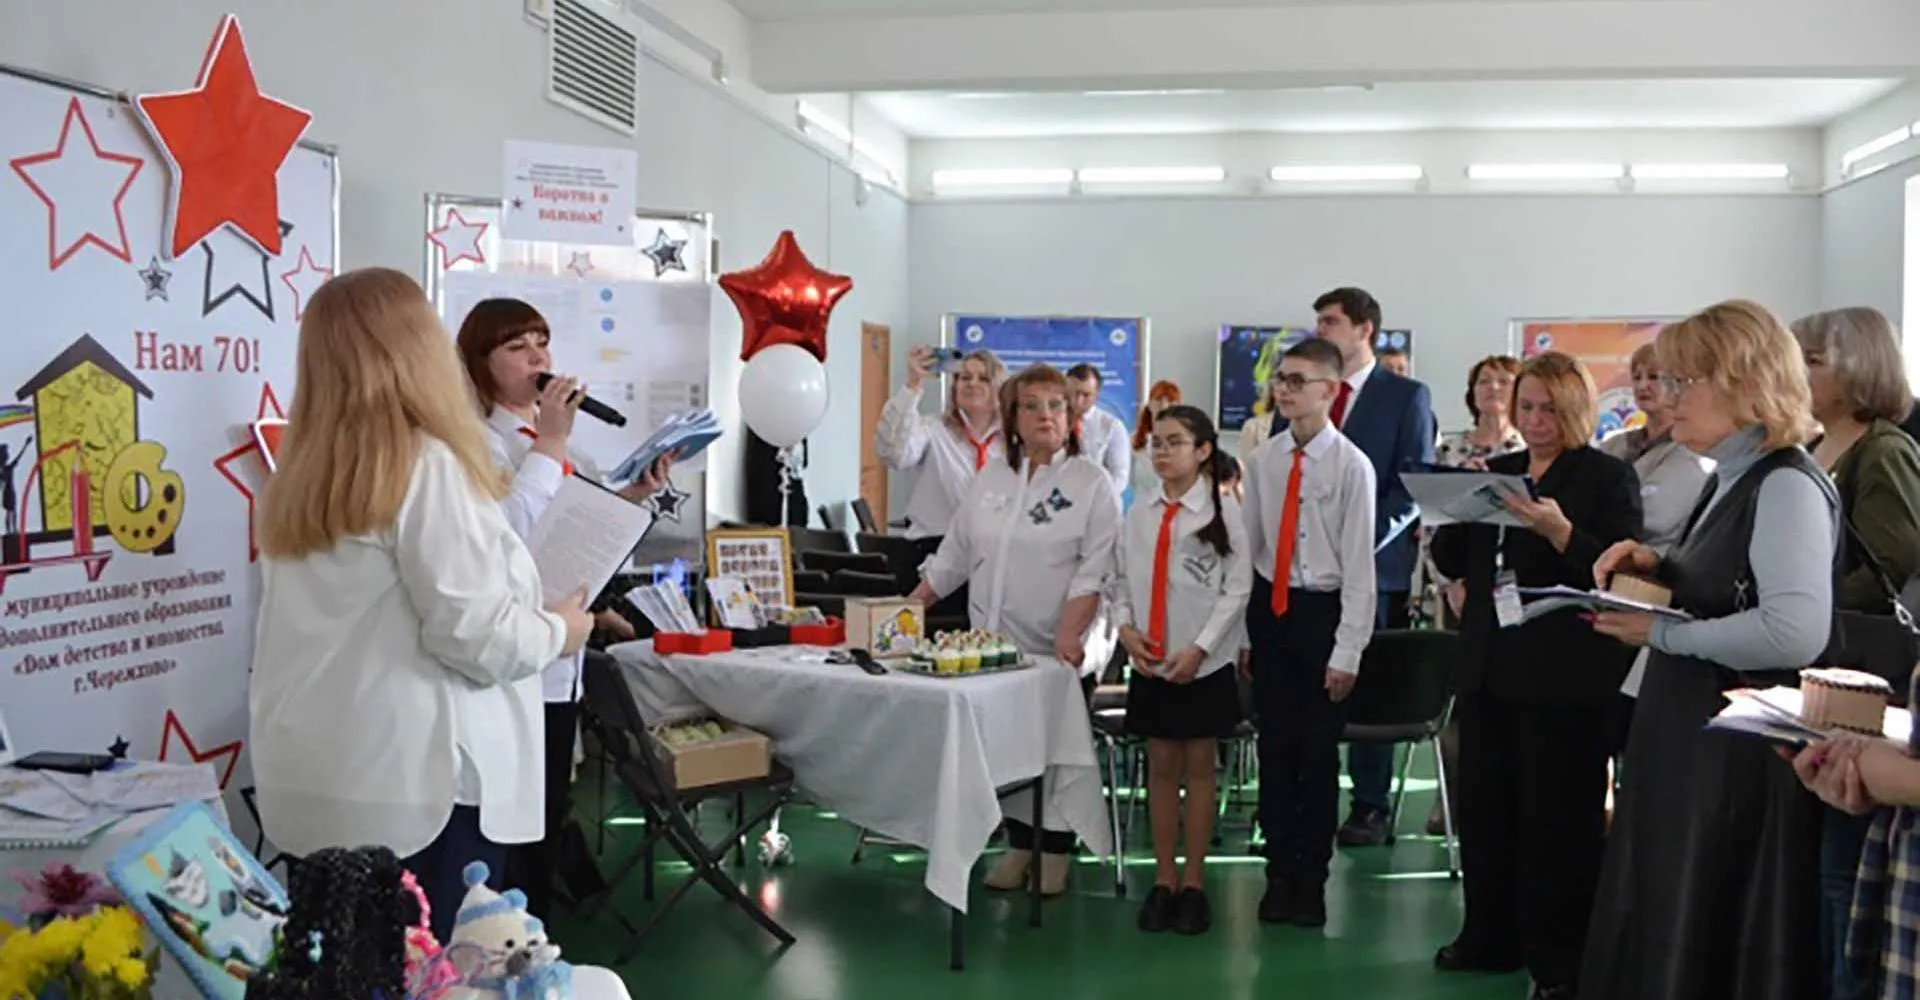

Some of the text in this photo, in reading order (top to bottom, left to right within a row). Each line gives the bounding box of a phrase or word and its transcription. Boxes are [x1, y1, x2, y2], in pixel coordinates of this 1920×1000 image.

[134, 329, 260, 374] Нам 70!
[4, 568, 226, 619] муниципальное учреждение
[144, 594, 232, 623] образования
[63, 640, 128, 666] детства
[131, 637, 141, 652] и
[144, 620, 225, 650] юношества
